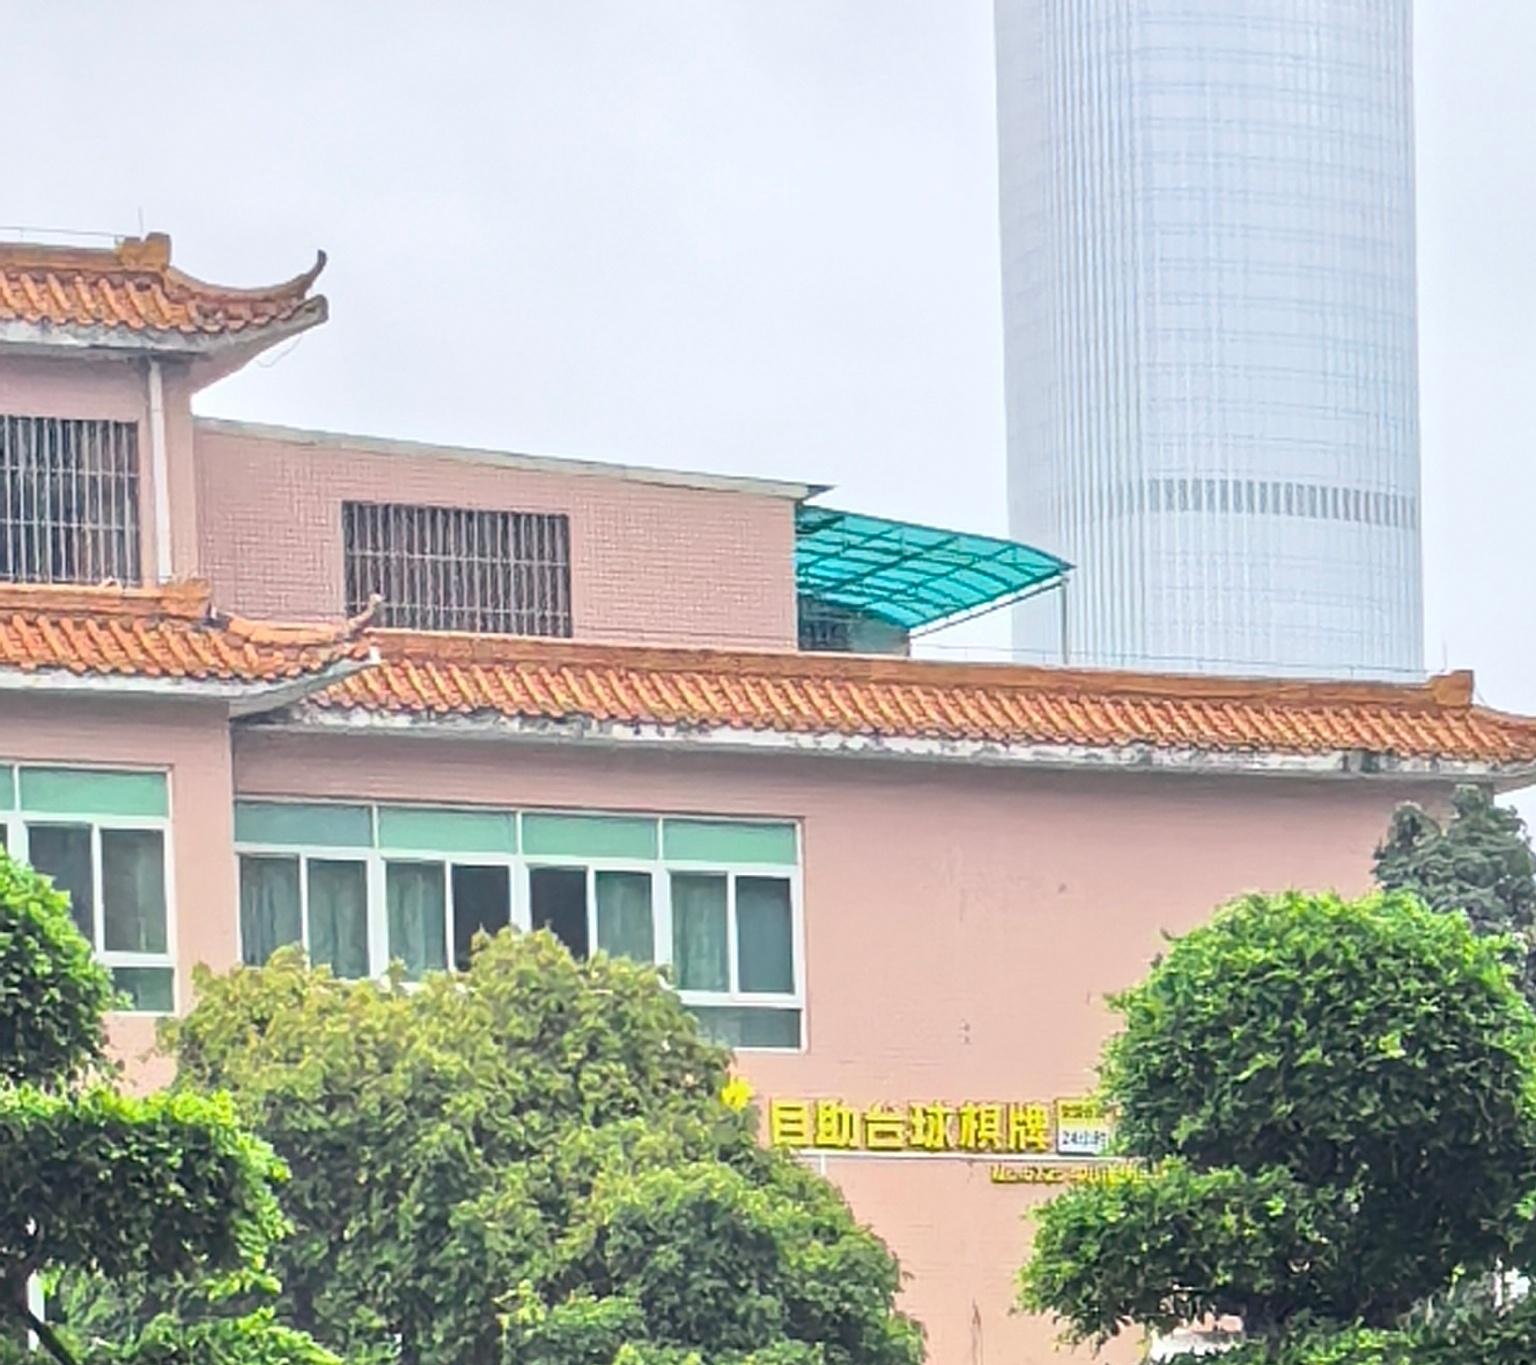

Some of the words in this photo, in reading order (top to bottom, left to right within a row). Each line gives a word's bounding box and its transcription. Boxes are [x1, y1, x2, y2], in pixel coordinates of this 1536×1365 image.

[771, 1098, 1050, 1151] 自助台球棋牌
